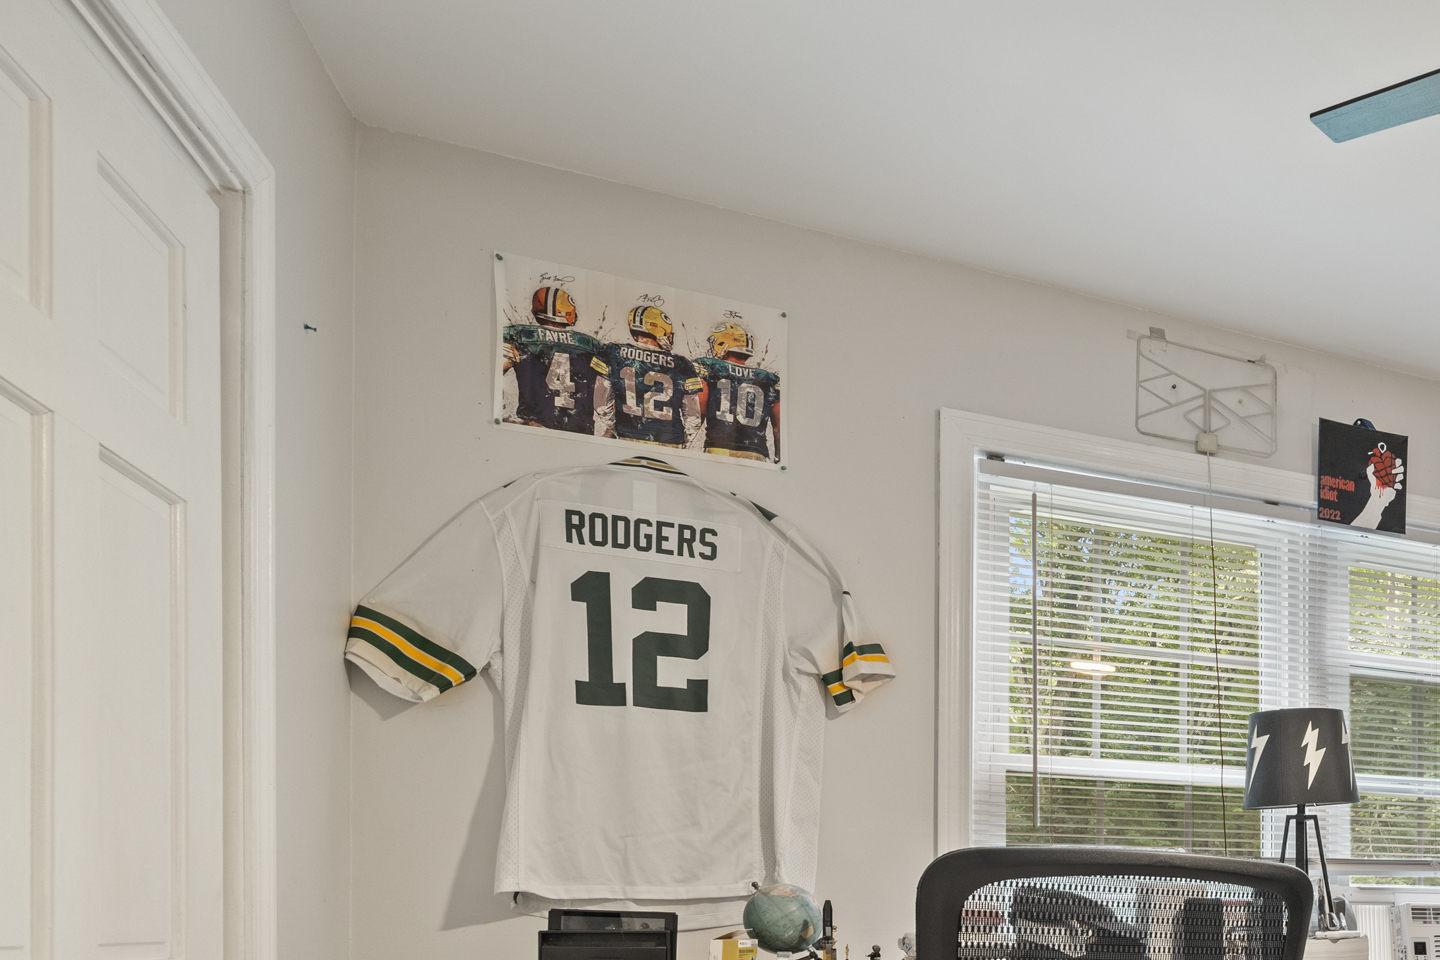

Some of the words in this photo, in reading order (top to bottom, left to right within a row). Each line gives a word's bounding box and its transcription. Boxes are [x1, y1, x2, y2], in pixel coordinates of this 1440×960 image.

[537, 328, 576, 345] FAVRE
[619, 346, 675, 369] RODGERS
[545, 352, 576, 409] 4
[728, 364, 755, 379] LOVE
[619, 365, 674, 421] 12
[715, 378, 765, 428] 10
[1319, 485, 1339, 502] idiot
[1320, 475, 1355, 492] american
[1318, 507, 1341, 521] 2022
[565, 508, 719, 562] RODGERS
[570, 570, 712, 713] 12
